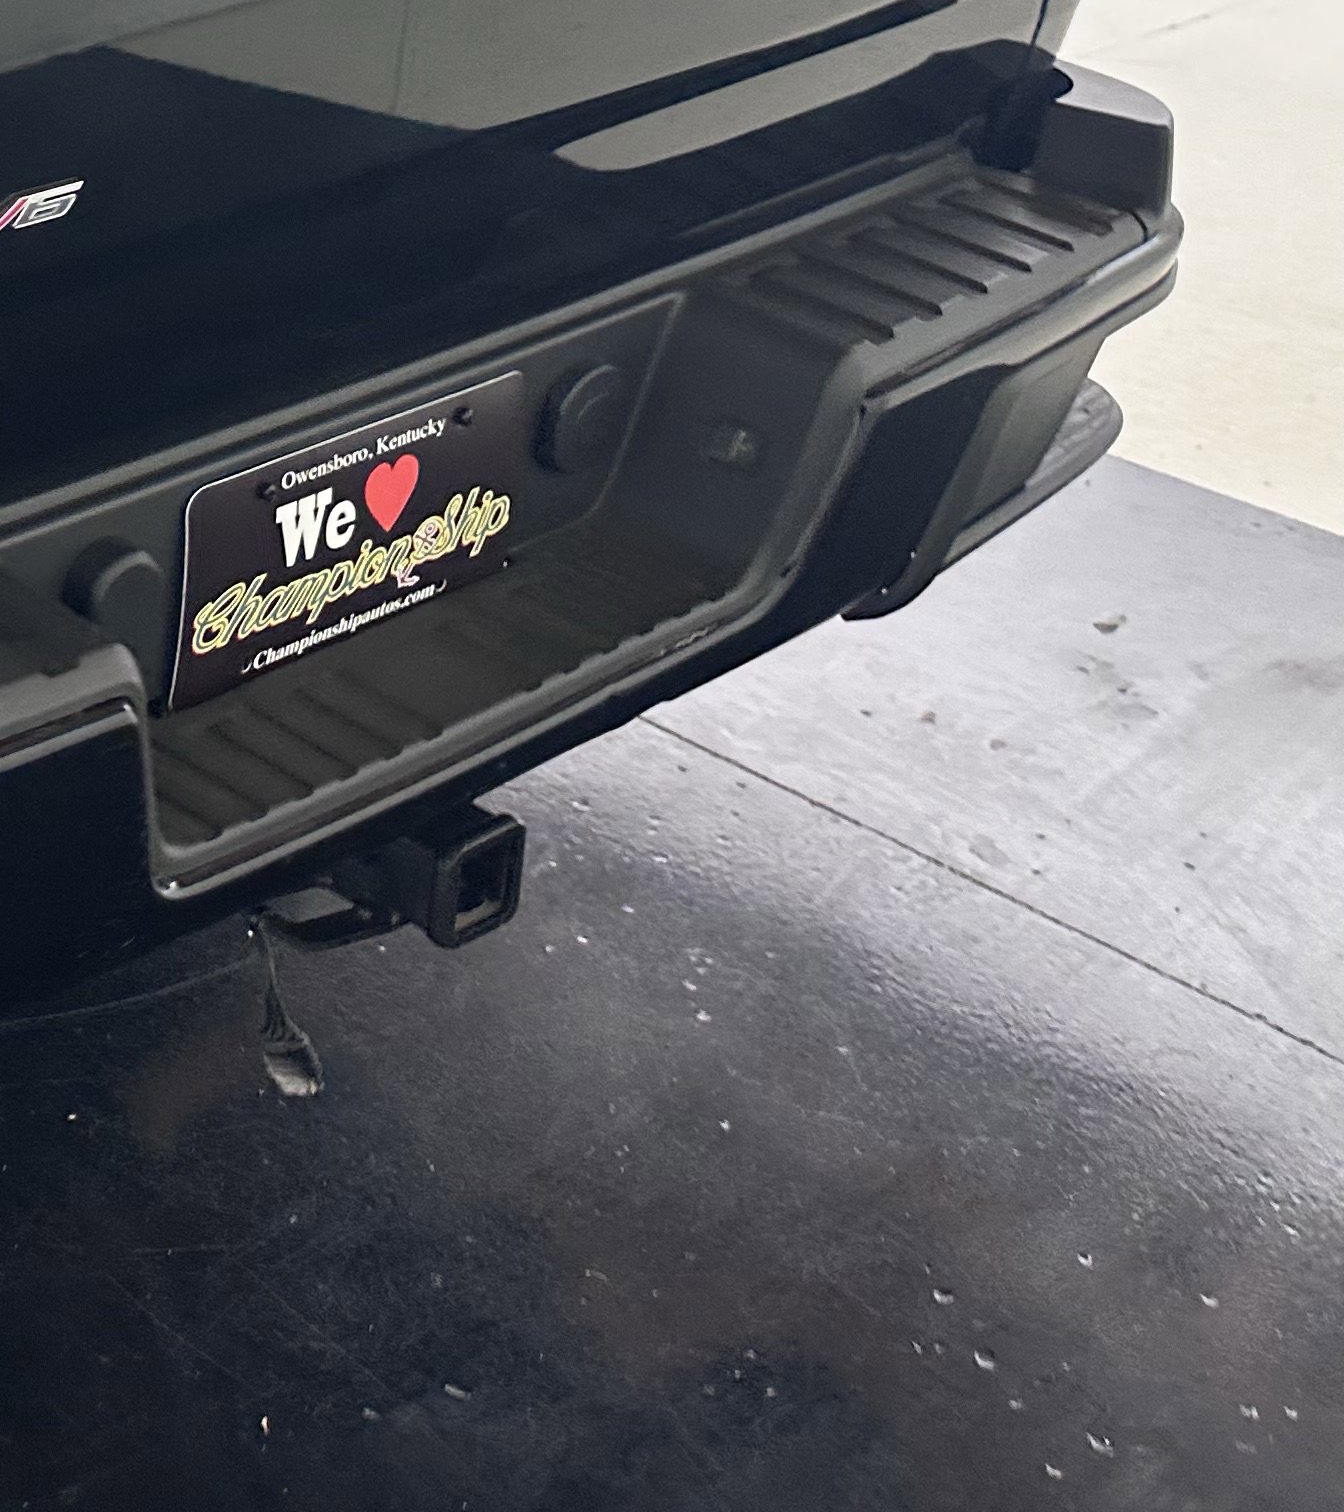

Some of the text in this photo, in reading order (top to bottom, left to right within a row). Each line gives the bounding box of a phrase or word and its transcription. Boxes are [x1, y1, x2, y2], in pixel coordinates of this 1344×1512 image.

[280, 418, 446, 490] Owensboro, Kentucky
[275, 486, 357, 568] We
[252, 583, 436, 670] Championshipautos.com
